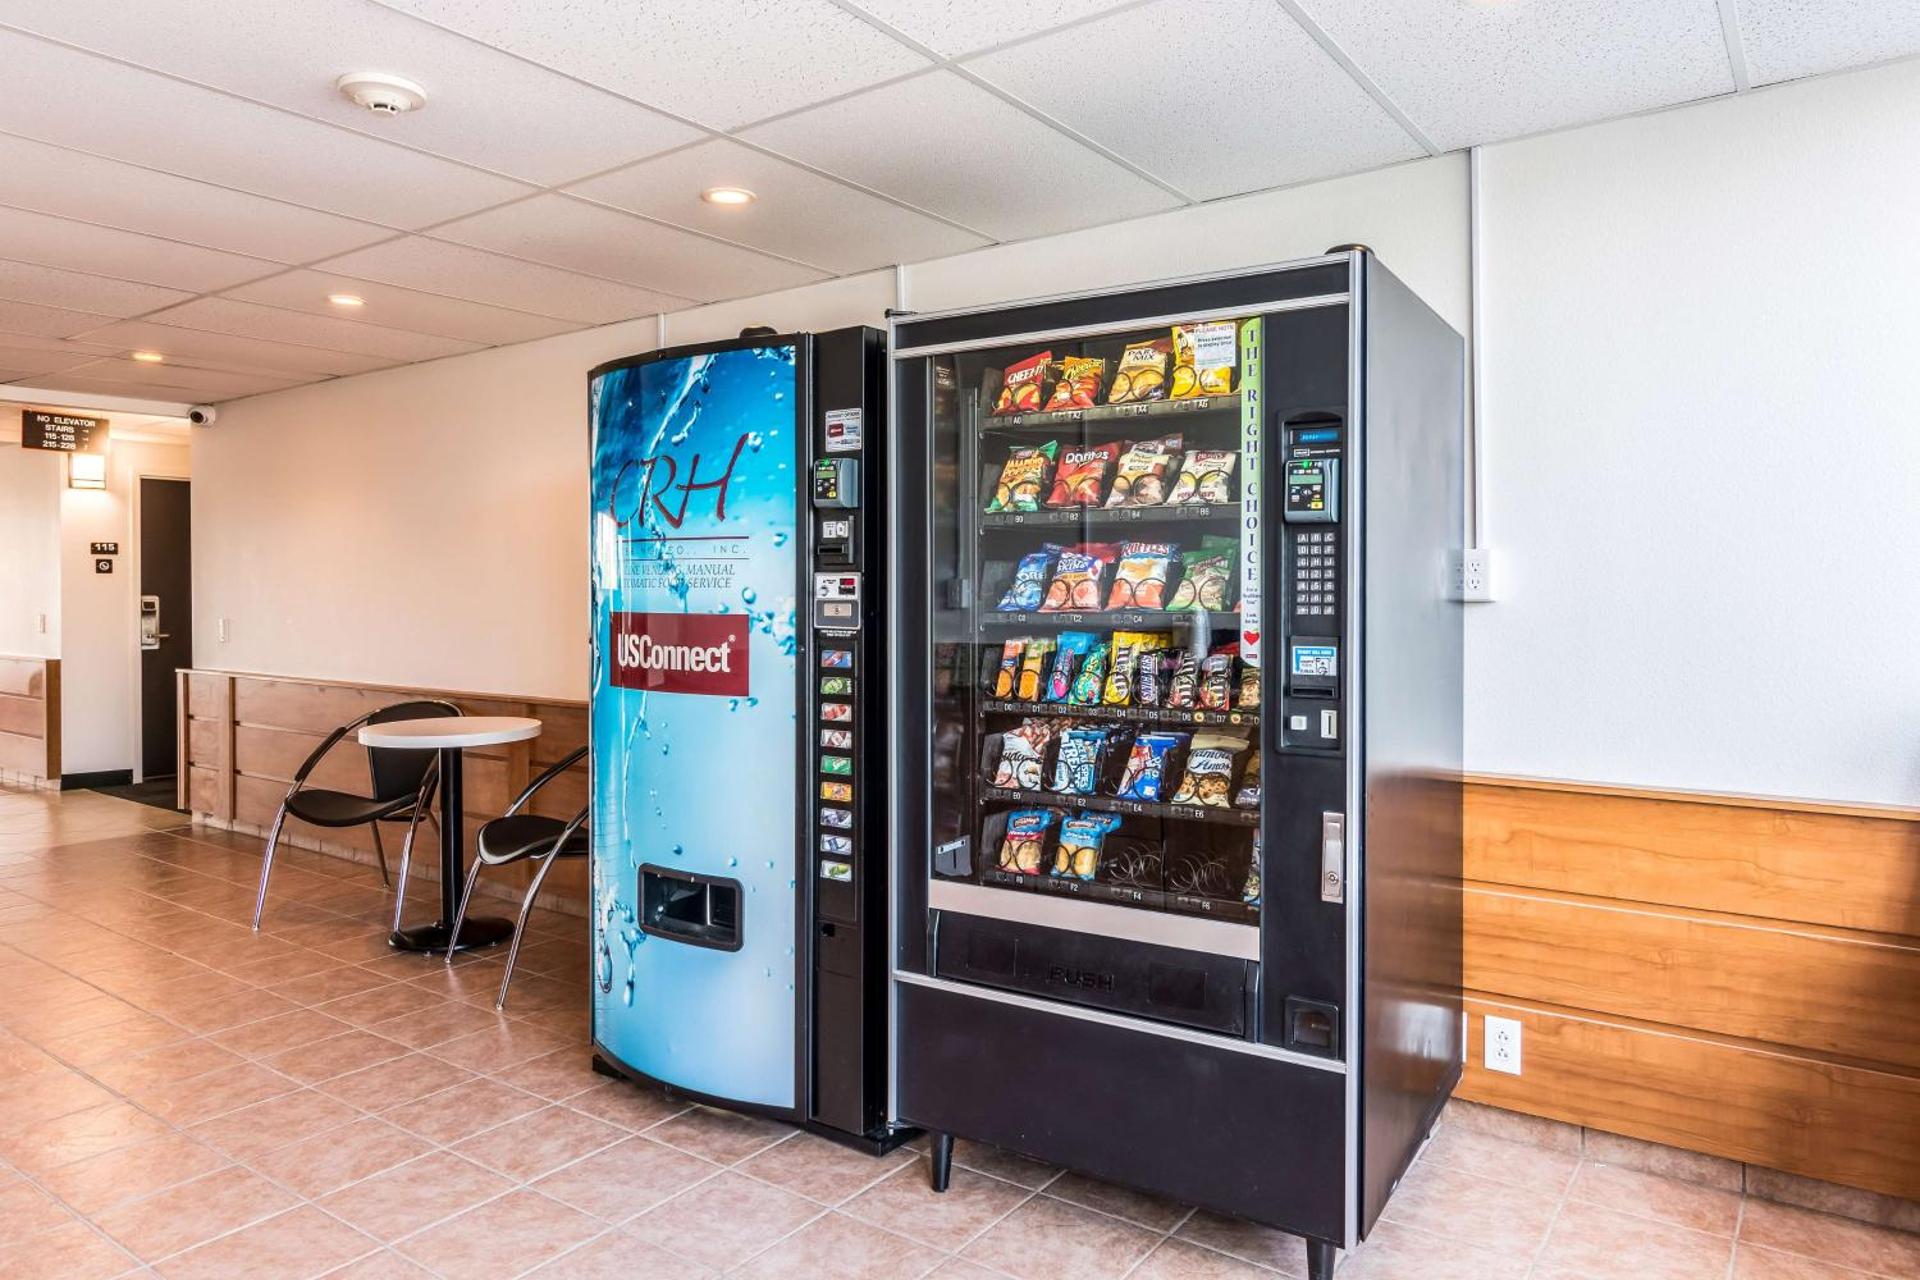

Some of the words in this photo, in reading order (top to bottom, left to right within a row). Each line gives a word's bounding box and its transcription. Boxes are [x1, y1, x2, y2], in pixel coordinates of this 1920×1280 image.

[37, 414, 50, 422] NO
[54, 417, 96, 427] ELEVATOR
[45, 424, 75, 433] STAIRS
[1065, 451, 1109, 464] Doritos
[1247, 483, 1258, 580] CHOICE
[95, 543, 115, 551] 115
[687, 563, 736, 575] MANUAL
[688, 577, 732, 588] SERVICE
